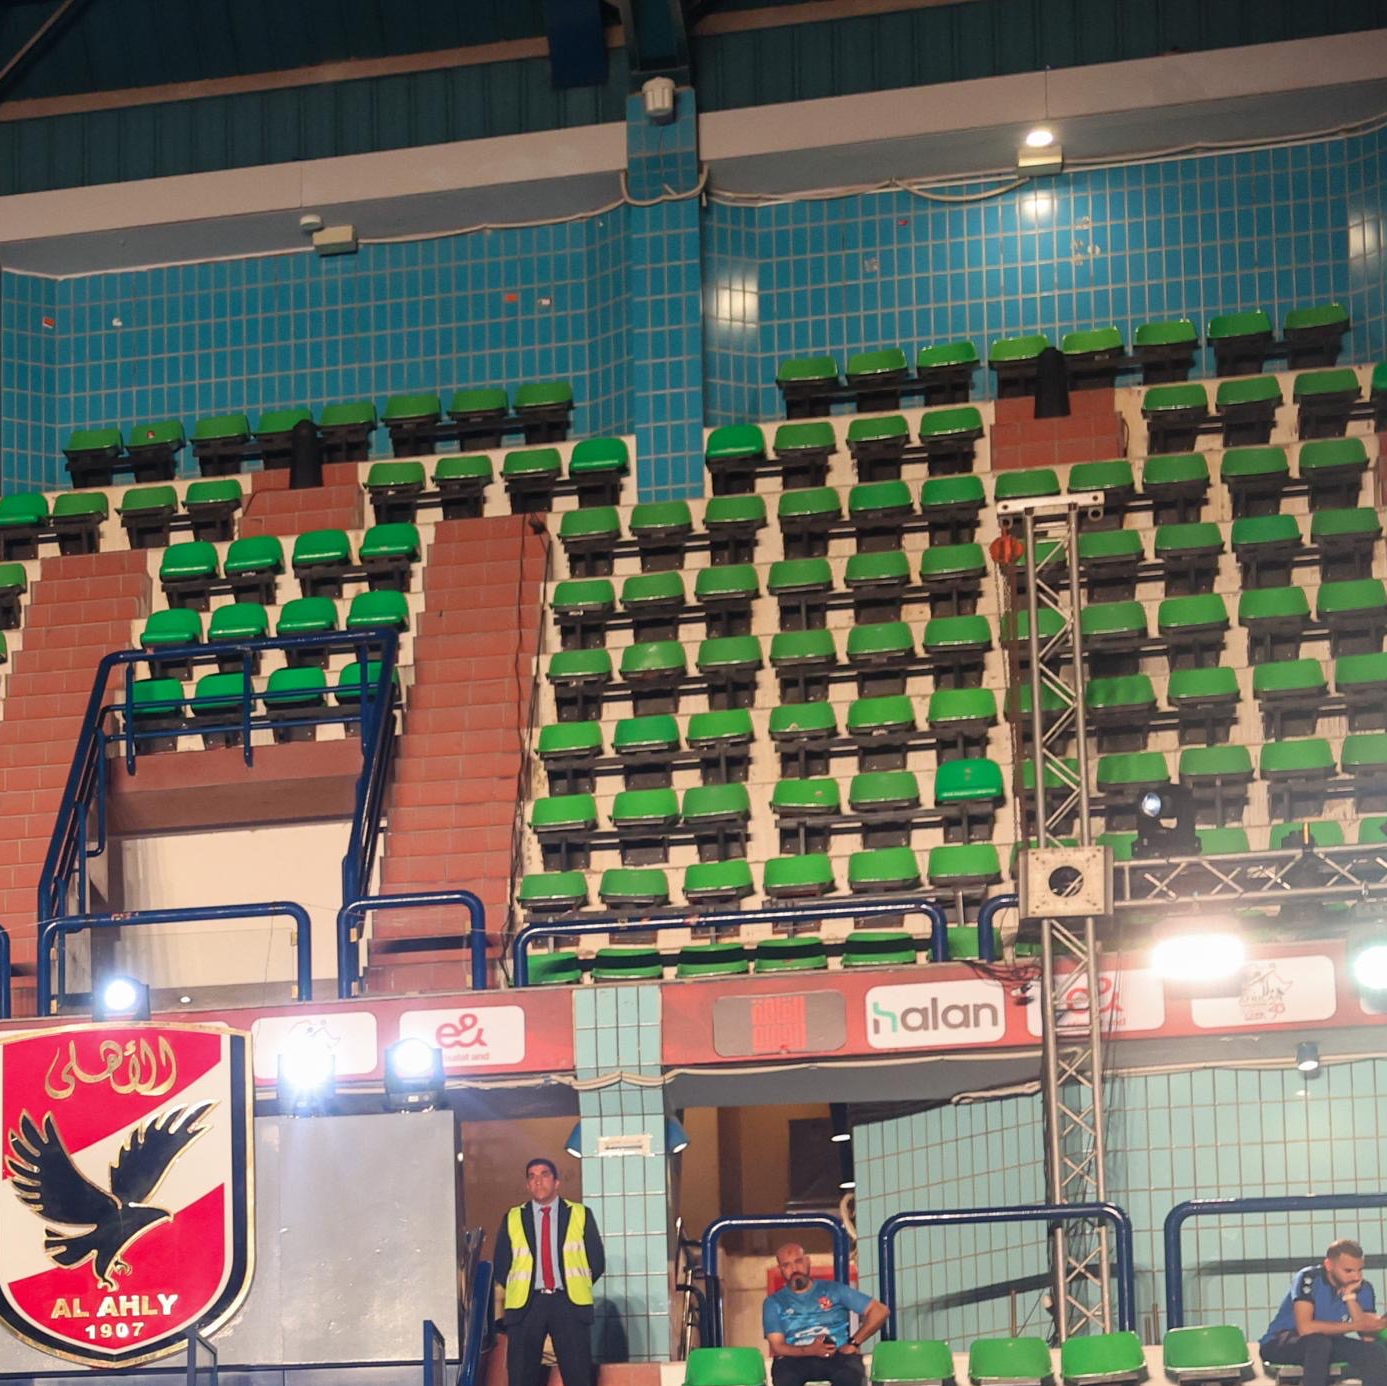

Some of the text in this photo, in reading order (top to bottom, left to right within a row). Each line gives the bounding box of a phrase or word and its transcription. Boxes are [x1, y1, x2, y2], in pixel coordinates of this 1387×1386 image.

[873, 998, 999, 1034] halan
[51, 1293, 178, 1319] AL AHLY
[85, 1321, 145, 1339] 1907
